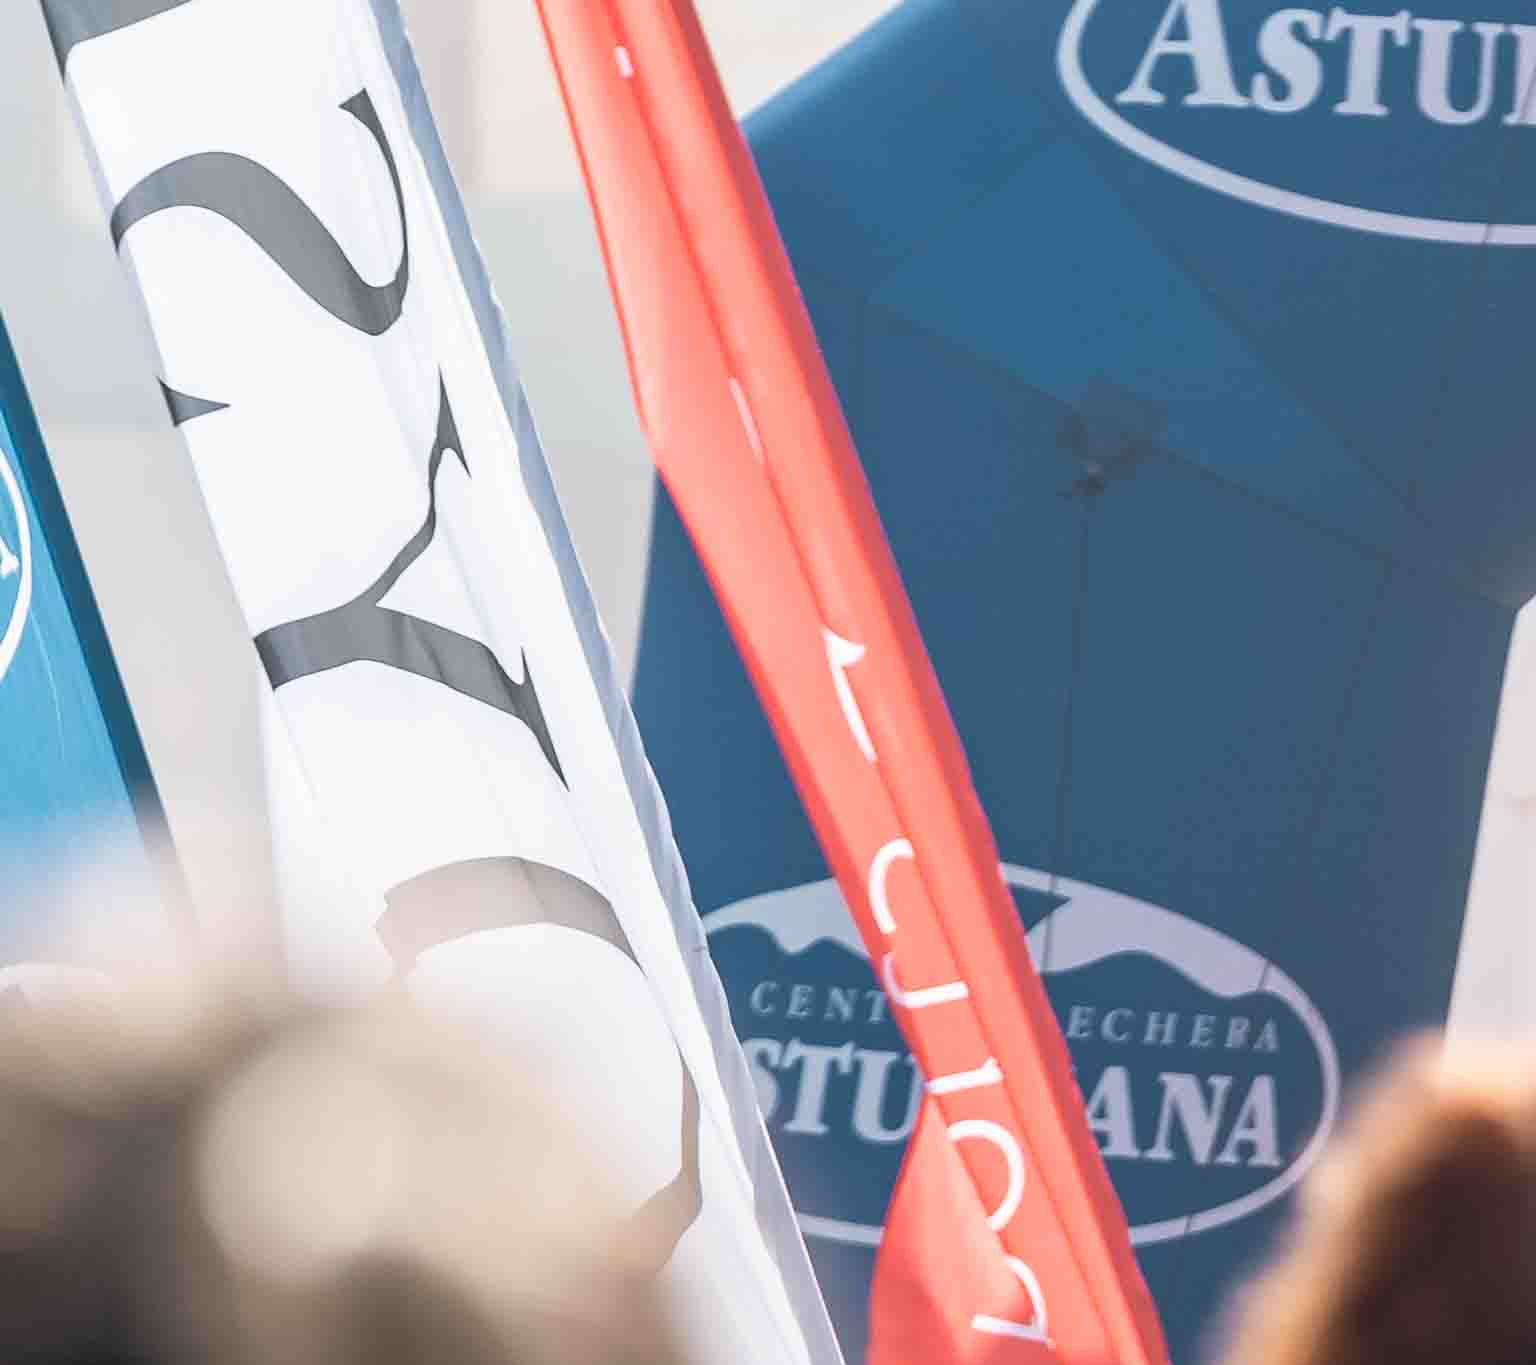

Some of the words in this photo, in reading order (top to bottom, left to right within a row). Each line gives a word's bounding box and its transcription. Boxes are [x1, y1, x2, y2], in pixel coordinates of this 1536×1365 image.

[751, 980, 888, 1024] CENT
[1066, 1004, 1280, 1053] ECHERA
[740, 1036, 1283, 1167] STUANA
